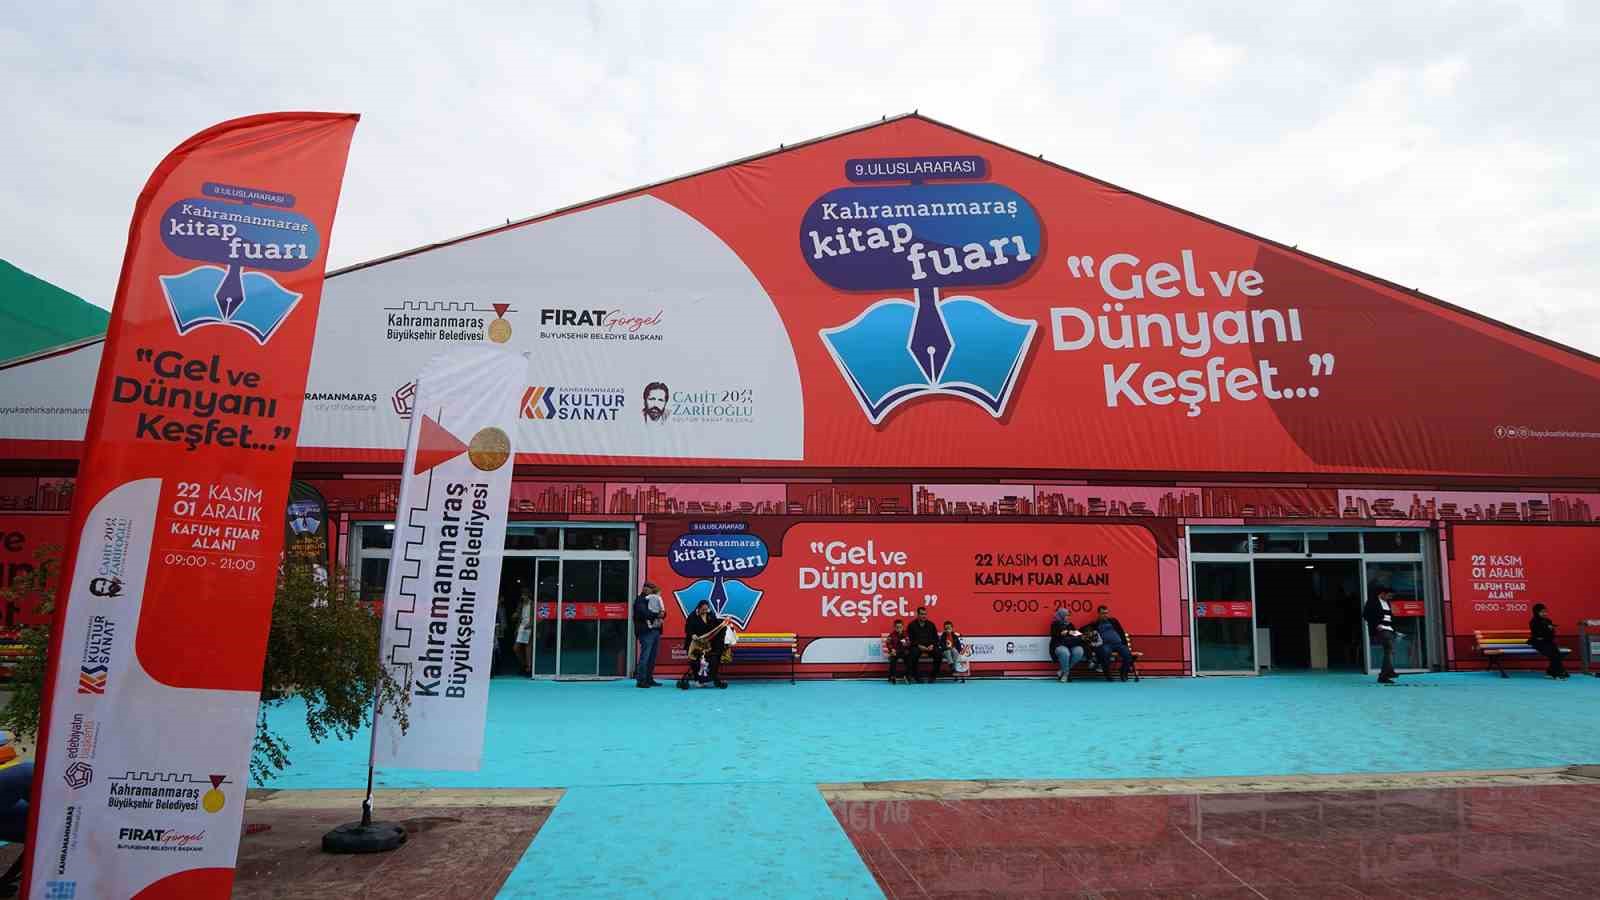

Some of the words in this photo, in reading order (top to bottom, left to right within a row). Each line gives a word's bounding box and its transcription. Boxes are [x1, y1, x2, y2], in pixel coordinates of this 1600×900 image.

[855, 161, 976, 176] 9.ULUSLARARASI
[181, 203, 309, 234] Kahramanmaraş
[821, 201, 1017, 219] Kahramanmaraş
[169, 217, 237, 241] kitap
[228, 237, 309, 260] fuarı
[808, 222, 913, 259] kitap
[907, 235, 1031, 280] fuarı
[1209, 269, 1265, 297] ve
[388, 313, 484, 329] Kahramanmaraş
[541, 309, 606, 326] FIRAT
[387, 329, 437, 342] Büyükşehir
[439, 330, 485, 341] Belediyesi
[1050, 302, 1303, 358] Dünyanı
[226, 369, 261, 388] ve
[112, 376, 277, 418] Dünyanı
[304, 392, 377, 403] RAMANMARAŞ
[558, 407, 619, 420] SANAT
[176, 481, 201, 498] 22
[208, 484, 263, 503] KASIM
[174, 500, 197, 516] 01
[201, 503, 263, 522] ARALIK
[171, 522, 220, 537] KAFUM
[224, 527, 261, 540] FUAR
[459, 483, 489, 582] Belediyesi
[192, 537, 237, 551] ALANI
[680, 538, 761, 549] Kahramanmaraş
[164, 553, 208, 567] 09:00
[220, 557, 256, 571] 21:00
[673, 548, 717, 562] kitap
[712, 555, 764, 573] fuarı
[880, 551, 908, 565] ve
[974, 553, 993, 567] 22
[997, 553, 1038, 567] KASIM
[1042, 553, 1060, 567] 01
[1063, 553, 1109, 567] ARALIK
[1472, 554, 1486, 566] 22
[1489, 554, 1522, 566] KASIM
[799, 566, 923, 595] Dünyanı
[974, 572, 1024, 586] KAFUM
[1027, 572, 1064, 586] FUAR
[1067, 572, 1110, 586] ALANI
[1488, 567, 1525, 578] ARALIK
[414, 483, 465, 698] Kahramanmaraş
[992, 600, 1040, 613] 09:00
[445, 585, 477, 699] Büyükşehir
[110, 782, 200, 799] Kahramanmaraş
[108, 796, 154, 811] Büyükşehir
[155, 799, 199, 812] Belediyesi
[119, 828, 166, 841] FIRAT
